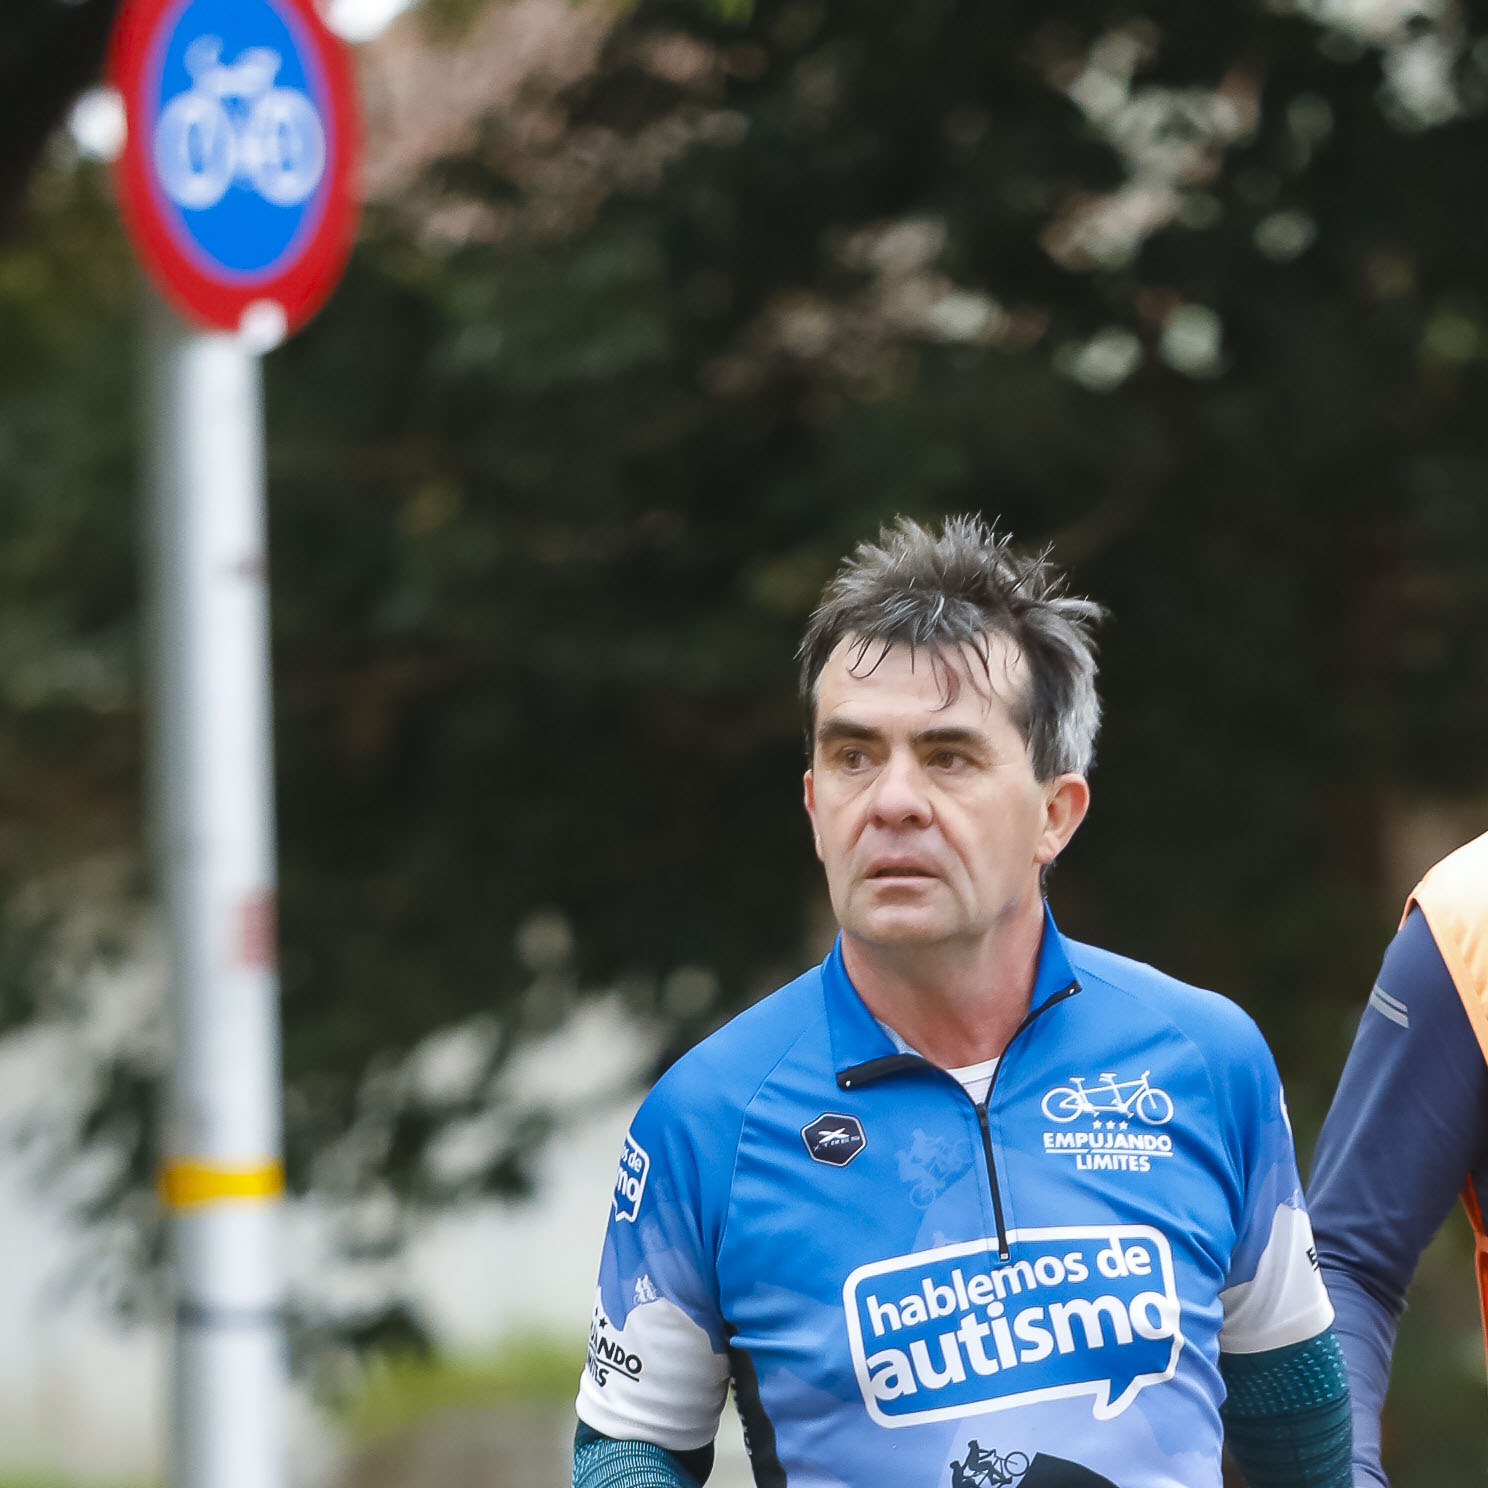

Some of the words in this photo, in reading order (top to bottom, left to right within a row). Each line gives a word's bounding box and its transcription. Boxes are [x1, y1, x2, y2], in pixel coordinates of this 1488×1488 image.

[1043, 1132, 1173, 1152] EMPUJANDO
[866, 1251, 1090, 1337] hablemos
[1096, 1235, 1152, 1278] de
[865, 1291, 1176, 1401] autismo
